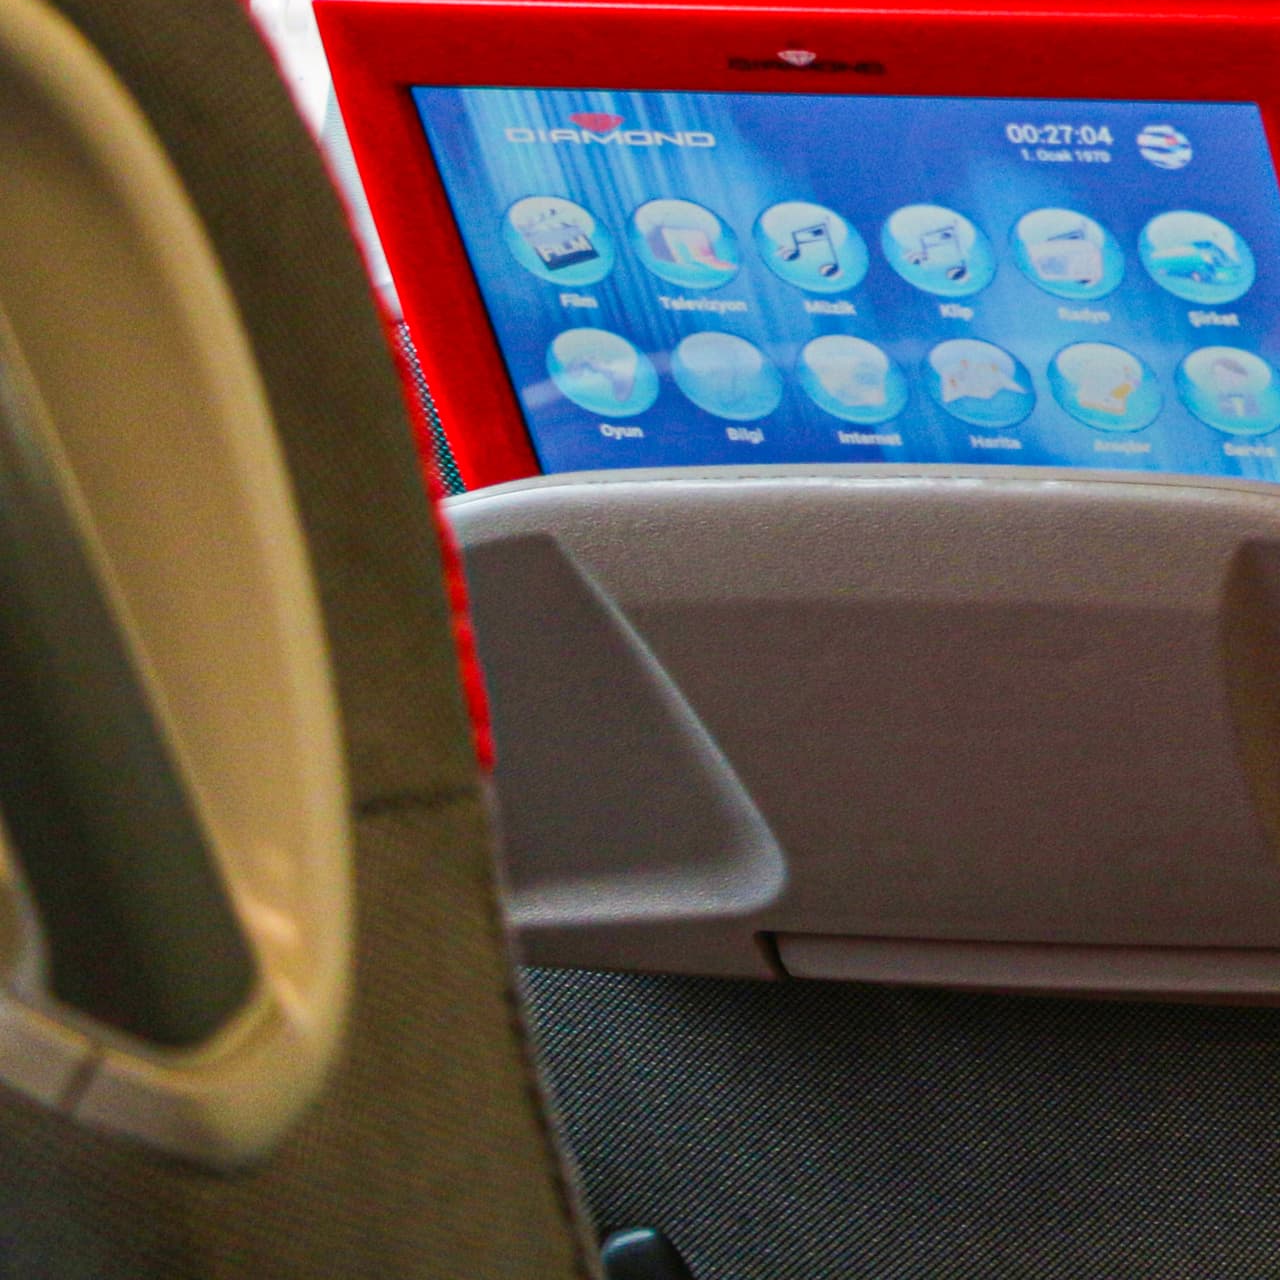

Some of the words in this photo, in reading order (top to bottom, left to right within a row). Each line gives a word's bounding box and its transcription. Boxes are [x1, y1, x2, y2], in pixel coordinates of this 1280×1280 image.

[503, 127, 716, 148] DIAMOND
[1006, 124, 1114, 146] 00:27:04
[560, 293, 599, 309] Film
[600, 423, 645, 440] Oyun
